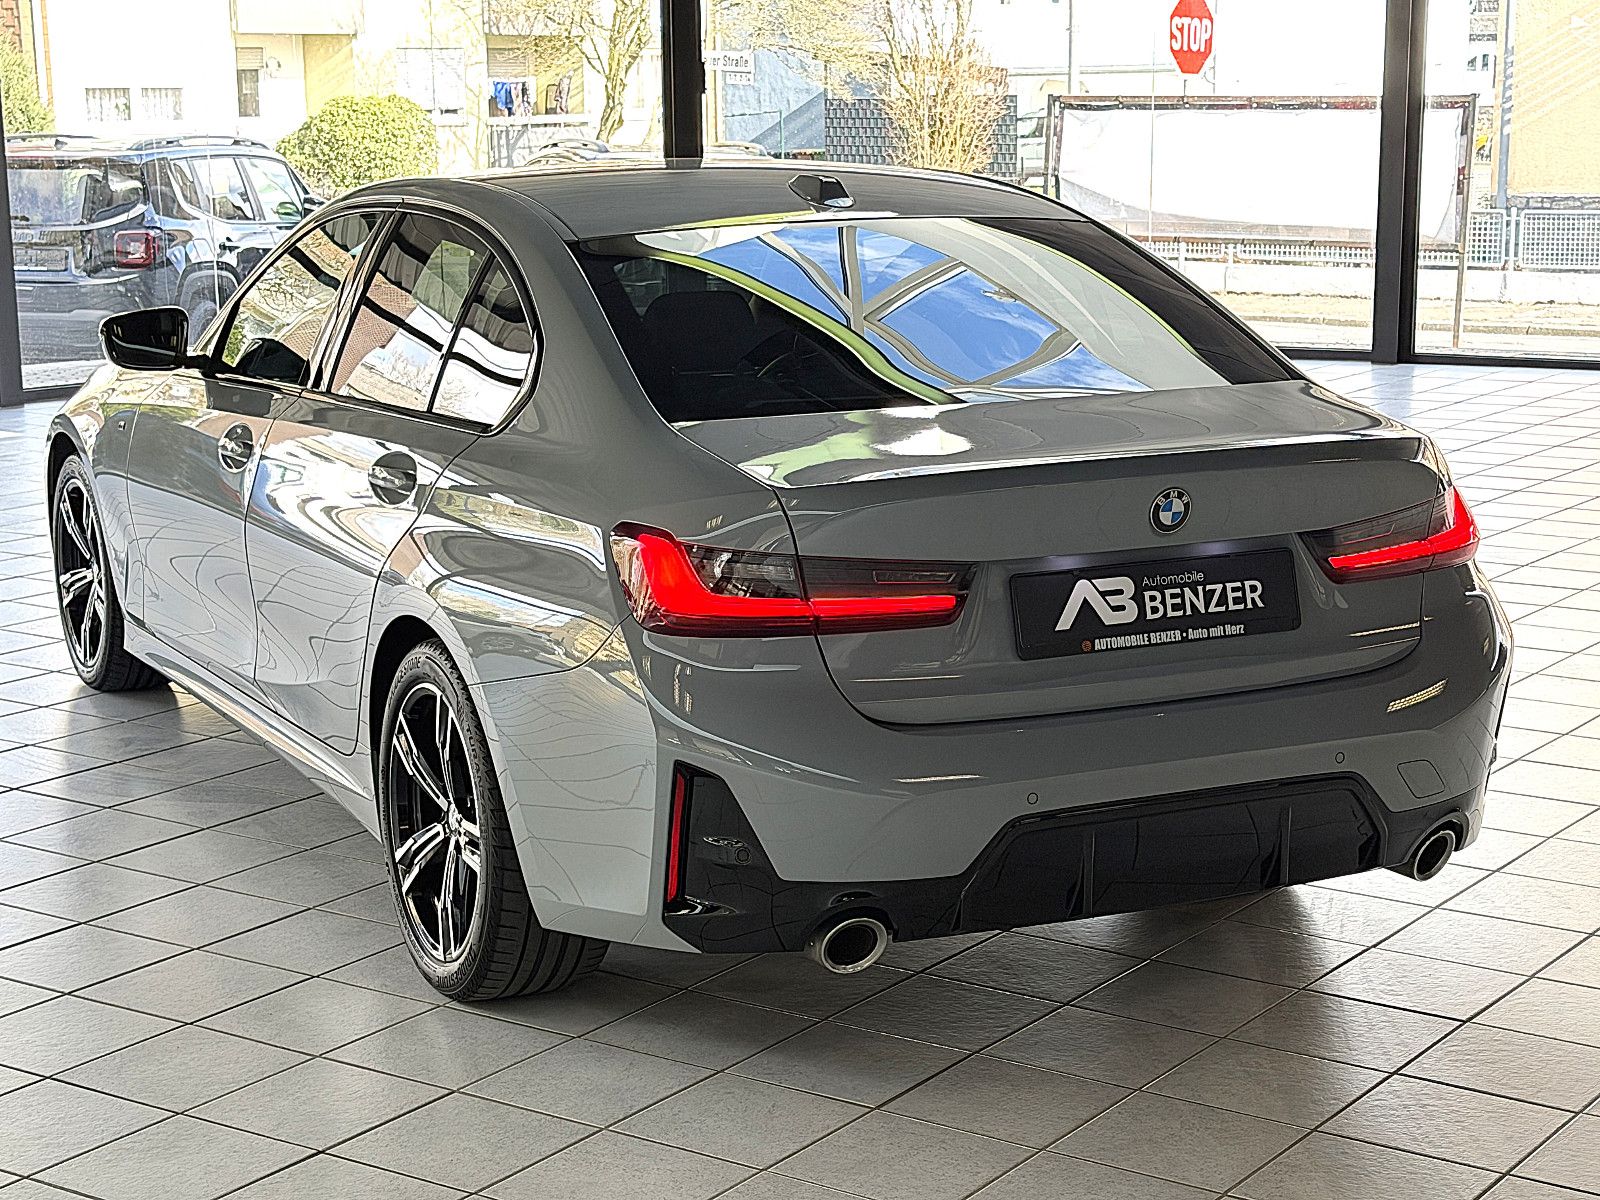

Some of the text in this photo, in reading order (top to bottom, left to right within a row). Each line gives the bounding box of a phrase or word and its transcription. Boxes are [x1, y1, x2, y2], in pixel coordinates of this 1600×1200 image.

[1171, 16, 1212, 52] STOP
[723, 55, 749, 67] Straße
[1157, 490, 1189, 506] BMW
[1142, 571, 1205, 587] Automobile
[1143, 580, 1265, 620] BENZER
[1094, 624, 1245, 651] AUTOMOBILE BENZER Auto mit Herz
